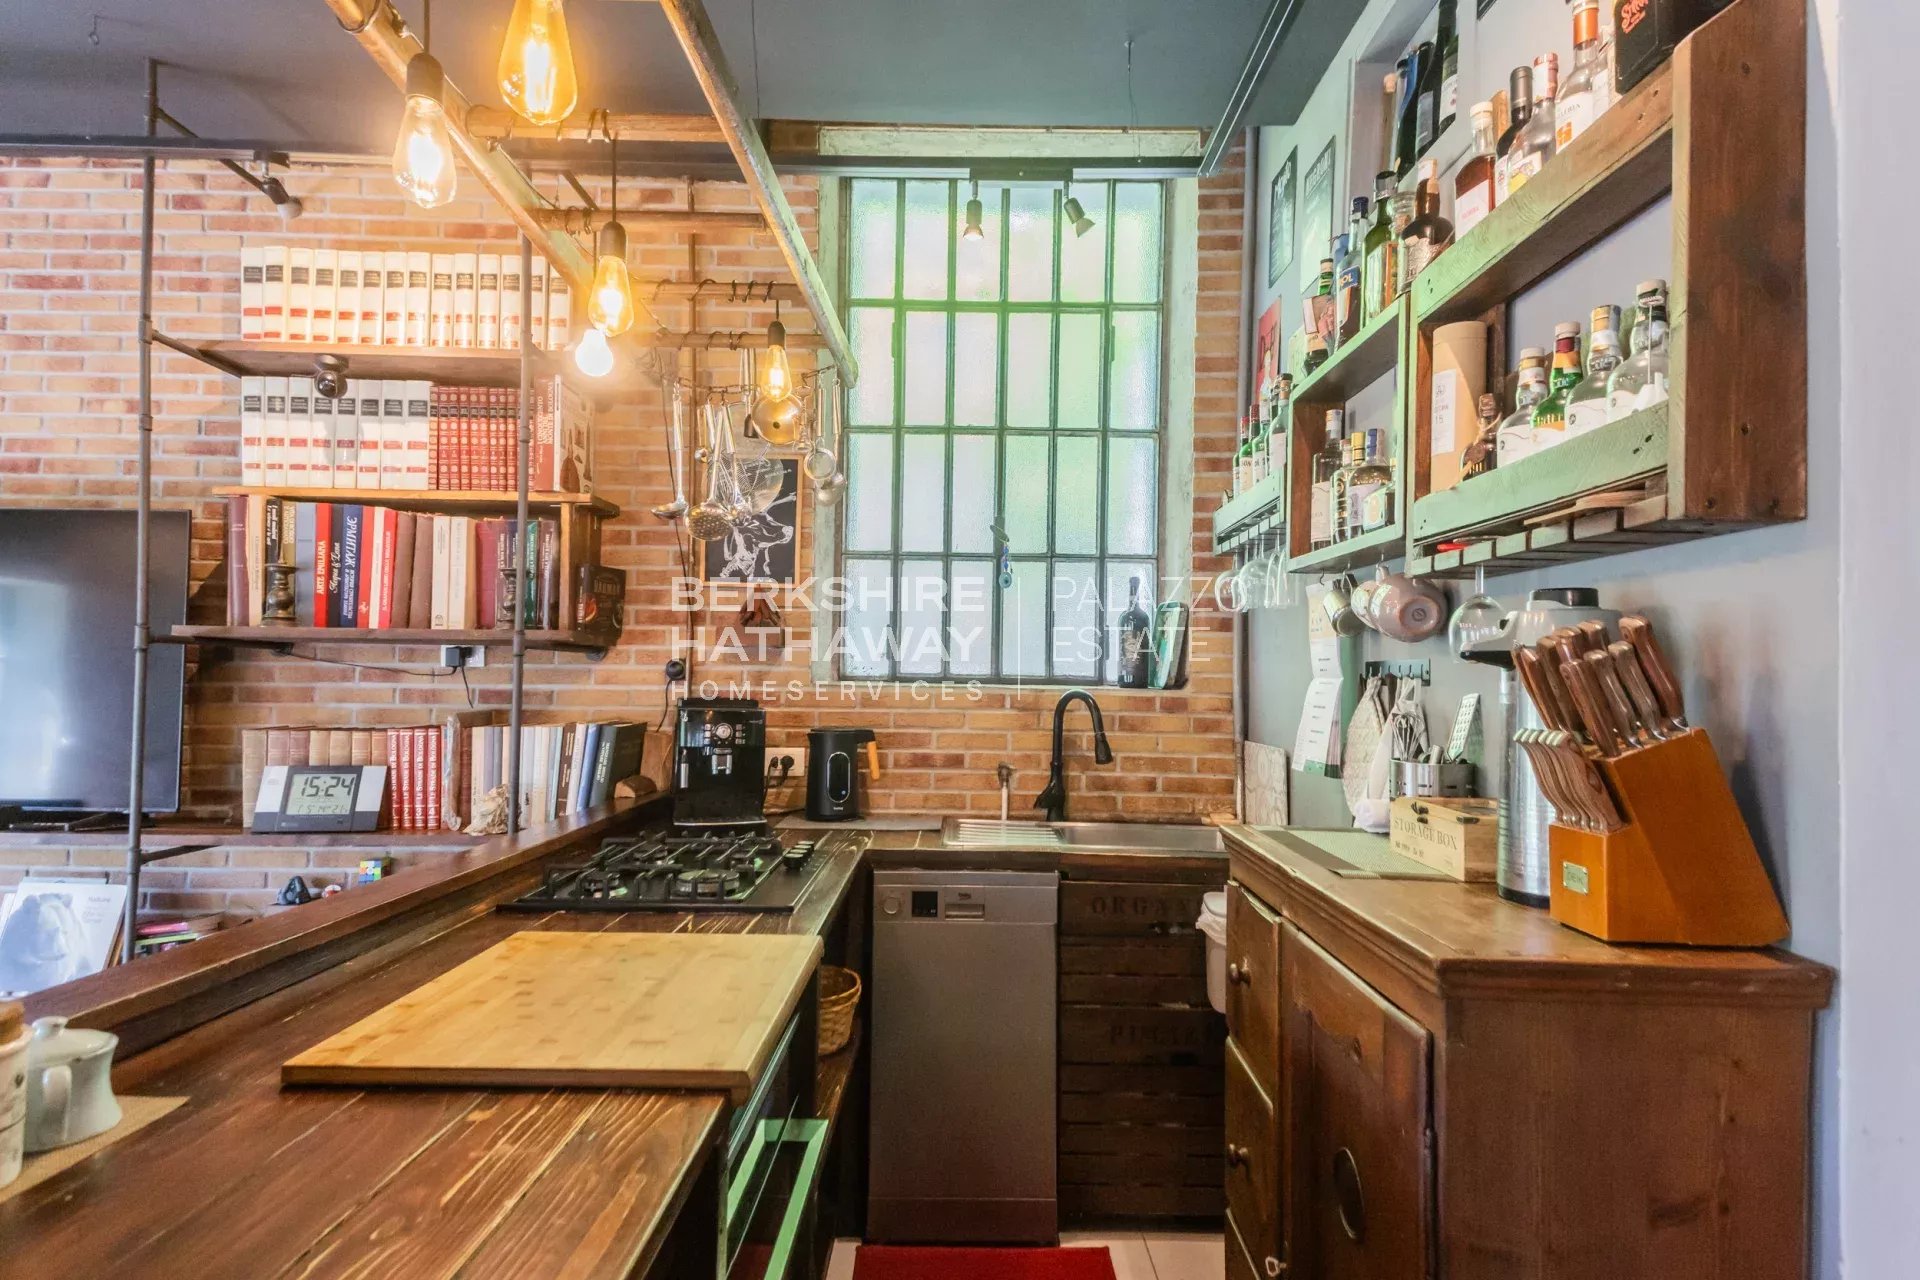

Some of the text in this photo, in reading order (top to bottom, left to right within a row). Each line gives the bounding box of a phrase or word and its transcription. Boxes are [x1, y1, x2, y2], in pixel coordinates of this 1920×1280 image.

[345, 516, 357, 568] ЭРМИТАЖ
[389, 735, 397, 761] BOLOGNA
[402, 735, 410, 761] BOLOGNA
[416, 735, 424, 762] BOLOGNA
[429, 735, 437, 761] BOLOGNA
[301, 776, 355, 797] 15:24
[416, 808, 424, 817] 3
[429, 808, 436, 816] 4
[1394, 817, 1436, 842] STORAGE
[1437, 831, 1457, 850] BOX
